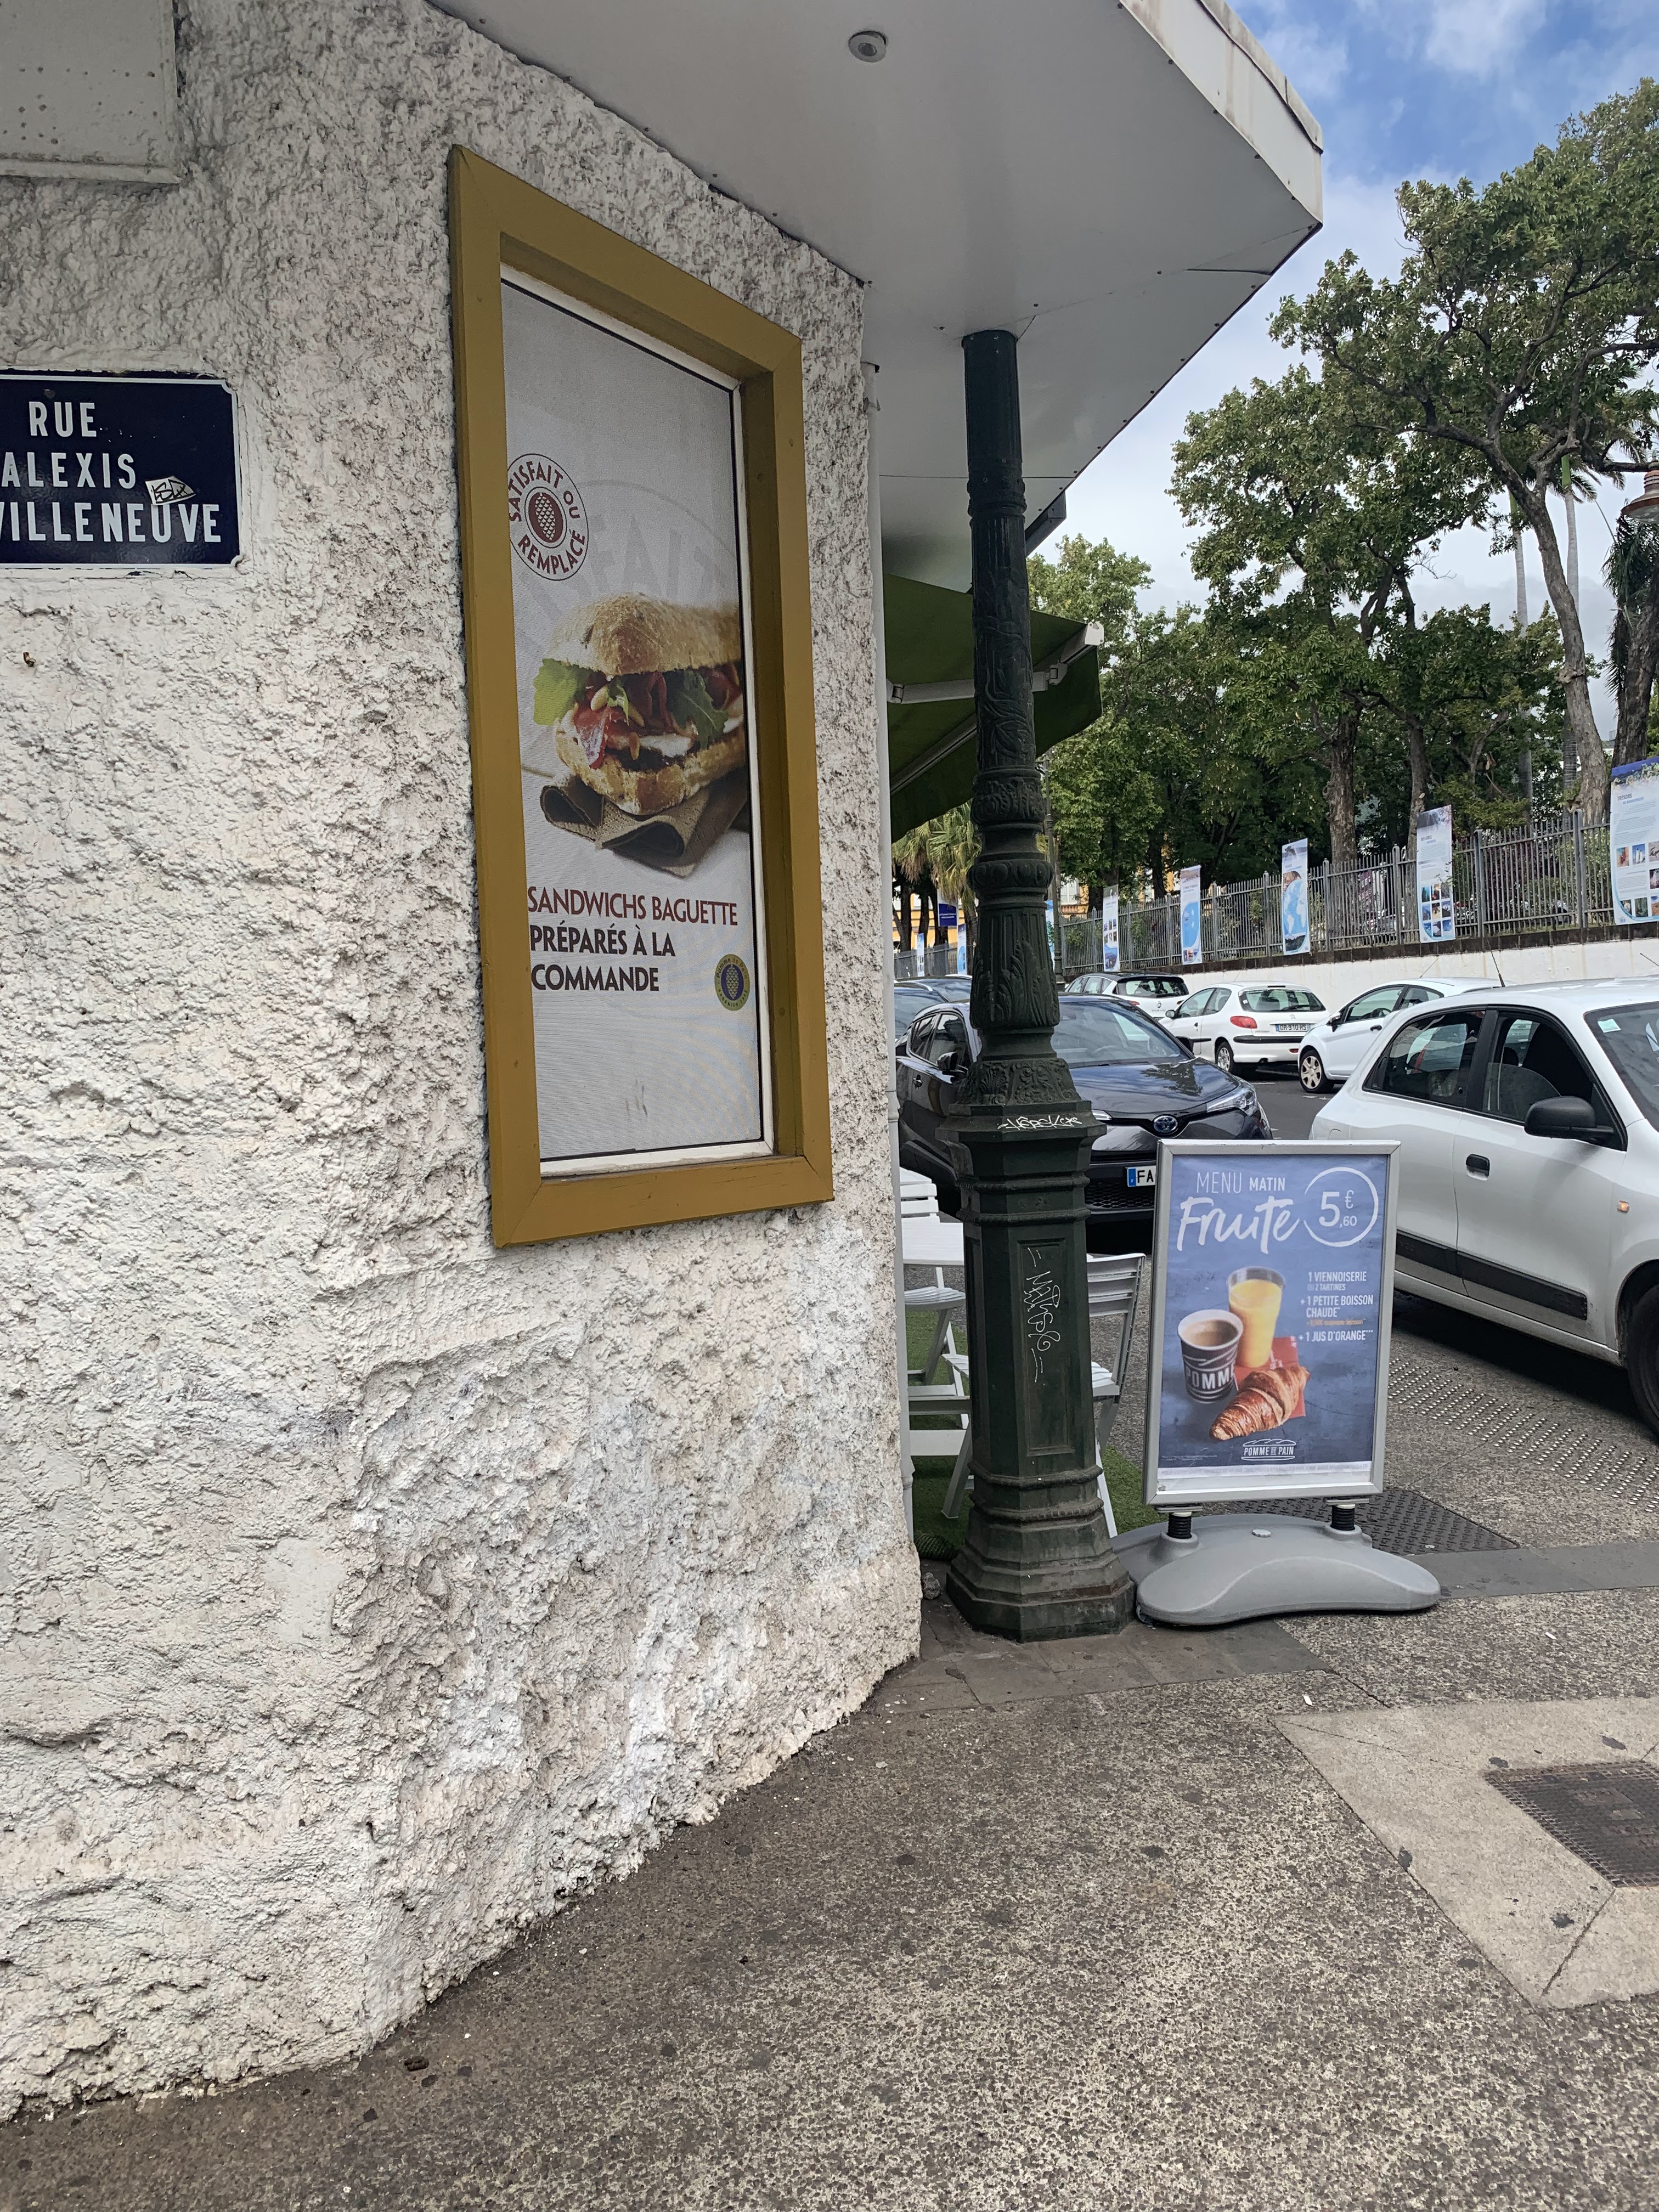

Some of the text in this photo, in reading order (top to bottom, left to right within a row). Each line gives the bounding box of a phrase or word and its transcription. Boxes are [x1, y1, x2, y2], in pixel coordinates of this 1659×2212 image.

[29, 401, 97, 437] RUE
[1, 452, 136, 489] ALEXIS
[509, 461, 563, 522] SATISFAIT
[563, 490, 580, 520] OU
[0, 501, 221, 543] ILLENEUVE
[528, 886, 738, 926] SANDWICHS BAGUETTE
[530, 919, 675, 957] PRÉPARÉS À LA
[531, 963, 659, 991] COMMANDE
[1197, 1172, 1285, 1194] MENU MATIN
[1308, 1271, 1367, 1282] 1 VIENNOISERIE
[1307, 1295, 1311, 1306] 1
[1313, 1295, 1339, 1306] PETITE
[1340, 1295, 1374, 1306] BOISSON
[1306, 1331, 1310, 1342] 1
[1311, 1331, 1327, 1342] JUS
[1244, 1447, 1269, 1456] POMME
[1278, 1446, 1294, 1455] PAIN
